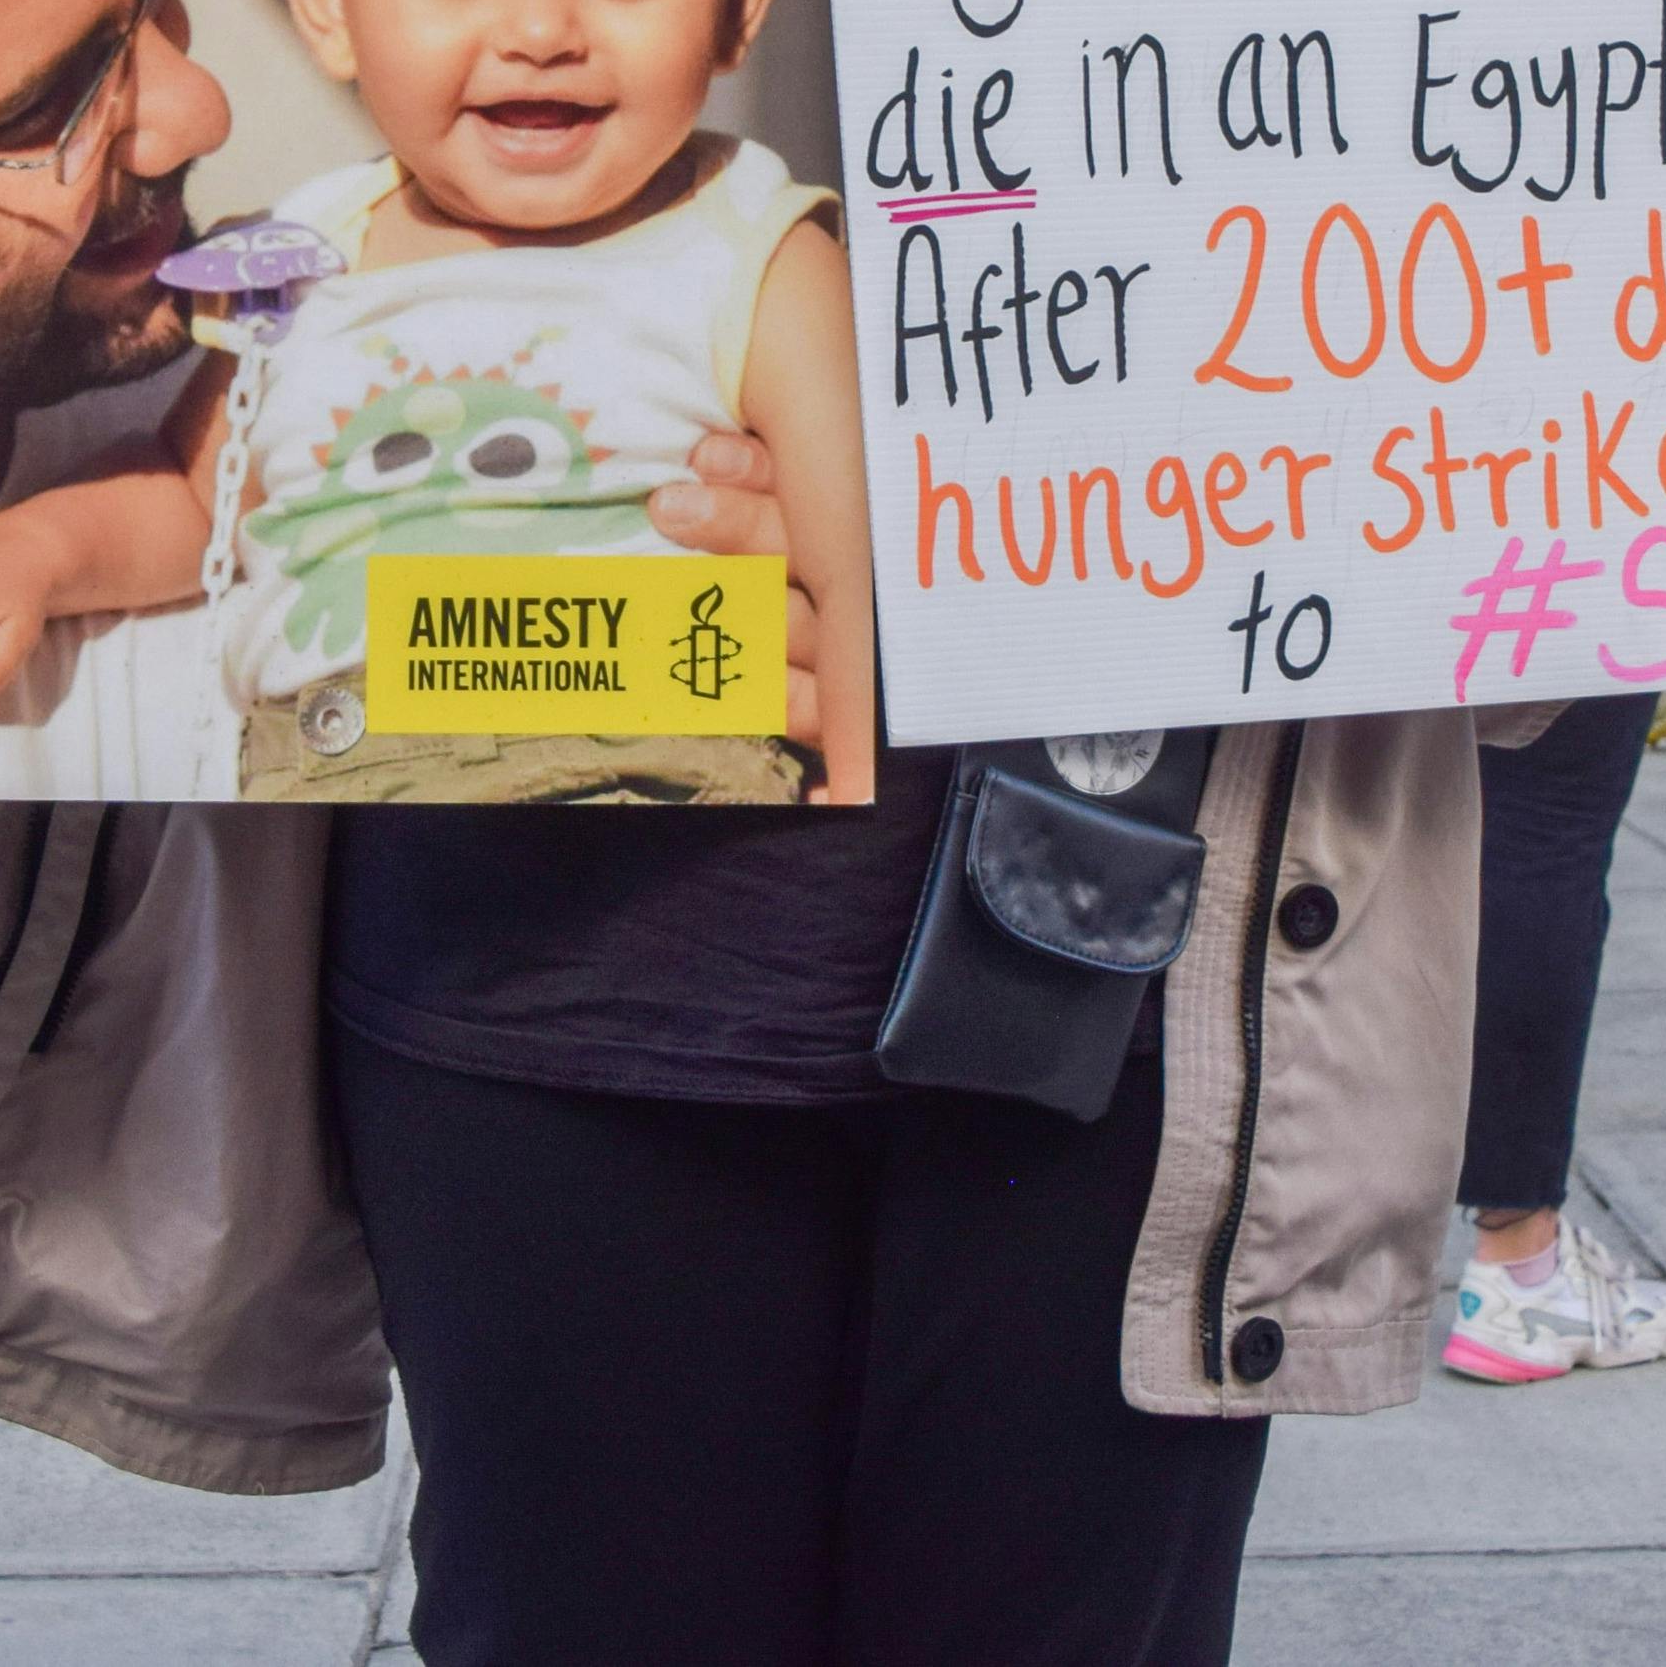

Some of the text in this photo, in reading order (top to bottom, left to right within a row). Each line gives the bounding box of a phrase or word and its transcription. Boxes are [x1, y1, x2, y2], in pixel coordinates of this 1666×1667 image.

[866, 46, 1031, 192] die
[1082, 33, 1183, 186] in
[1218, 30, 1349, 159] an
[895, 222, 1151, 423] After
[1194, 202, 1573, 393] 200+
[915, 433, 1332, 599] hunger
[408, 597, 627, 649] AMNESTY
[408, 660, 626, 692] INTERNATIONAL
[1228, 570, 1332, 695] to
